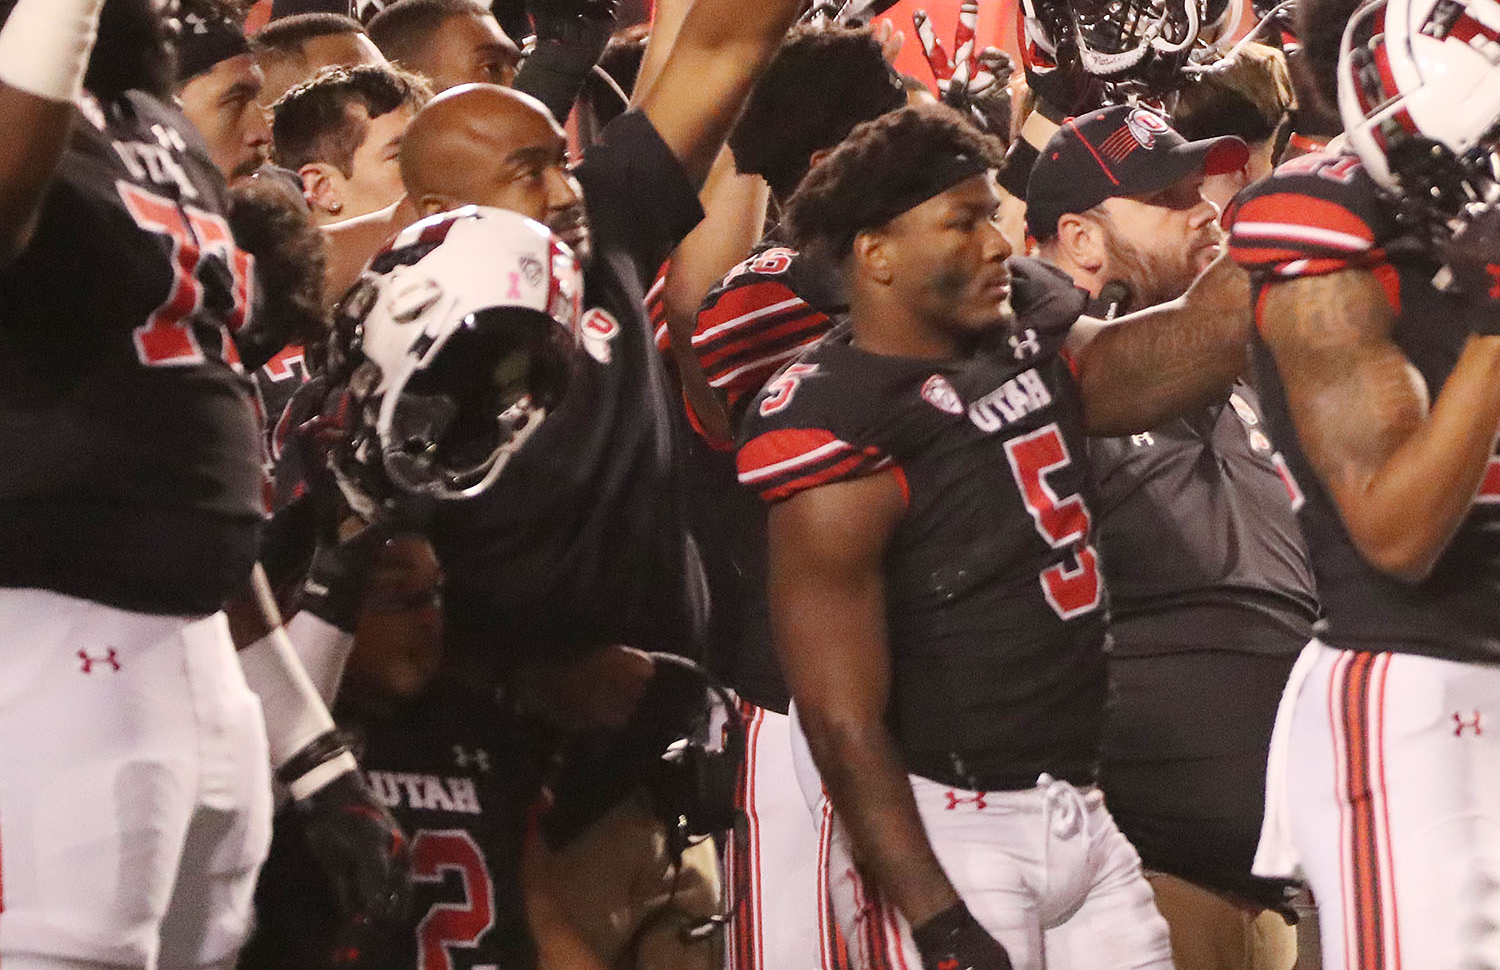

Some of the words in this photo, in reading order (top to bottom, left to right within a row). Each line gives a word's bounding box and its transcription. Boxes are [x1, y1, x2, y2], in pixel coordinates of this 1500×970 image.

[759, 362, 820, 417] 5
[968, 368, 1052, 432] UTAH
[1003, 422, 1102, 620] 5
[368, 770, 483, 814] UTAH
